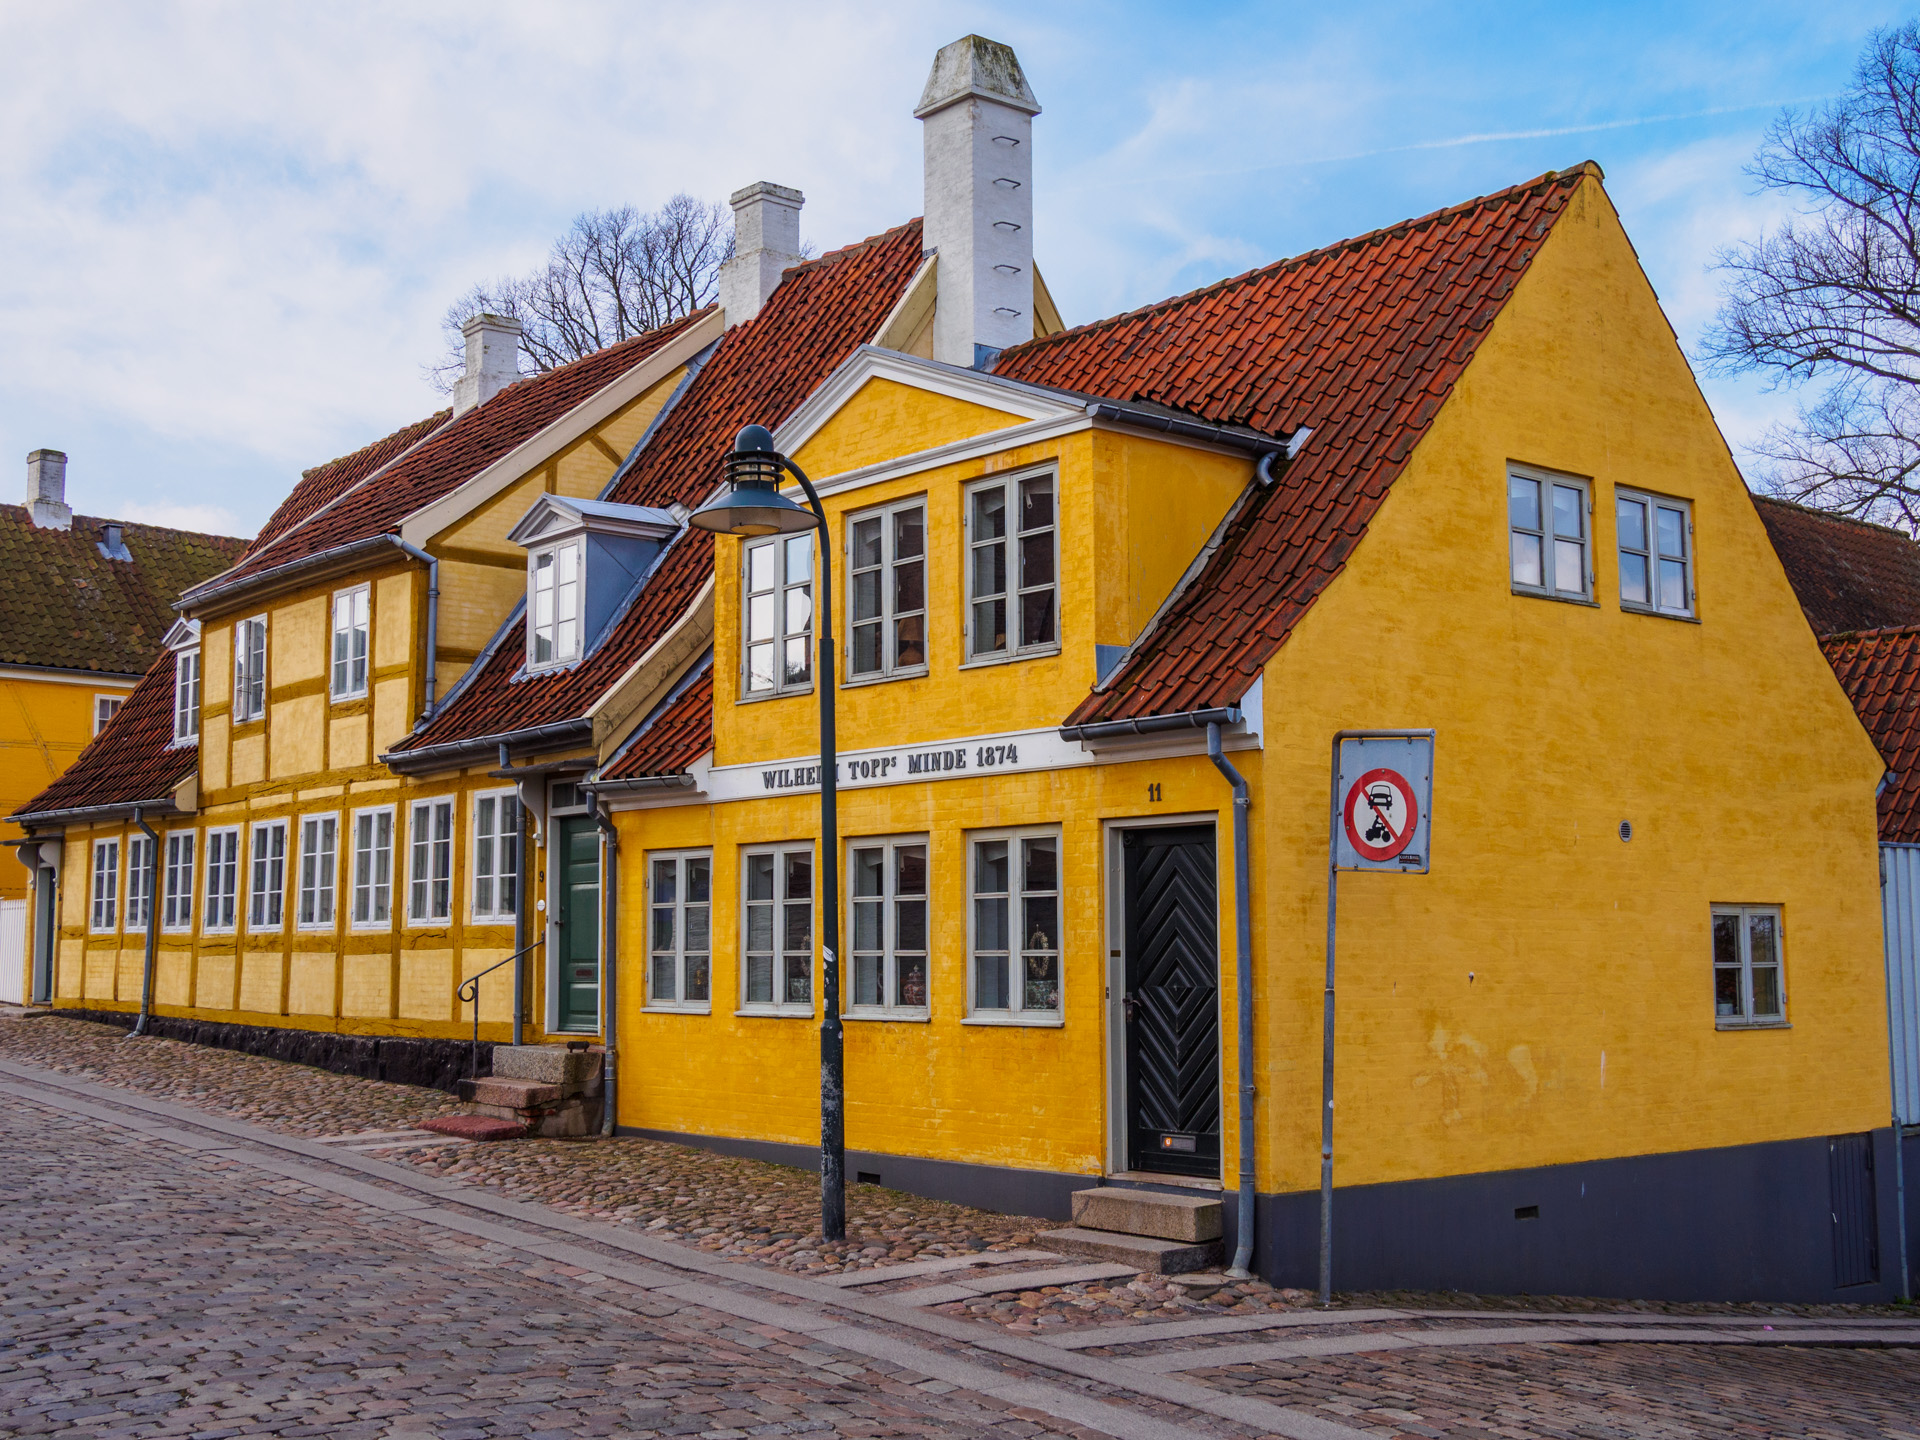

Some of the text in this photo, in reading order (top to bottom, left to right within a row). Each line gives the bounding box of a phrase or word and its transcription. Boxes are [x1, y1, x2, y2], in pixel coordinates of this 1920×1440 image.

[762, 763, 839, 789] WILHEL
[907, 748, 966, 774] MINDE
[976, 743, 1018, 767] 1874
[1147, 782, 1162, 802] 11
[539, 870, 544, 883] 9
